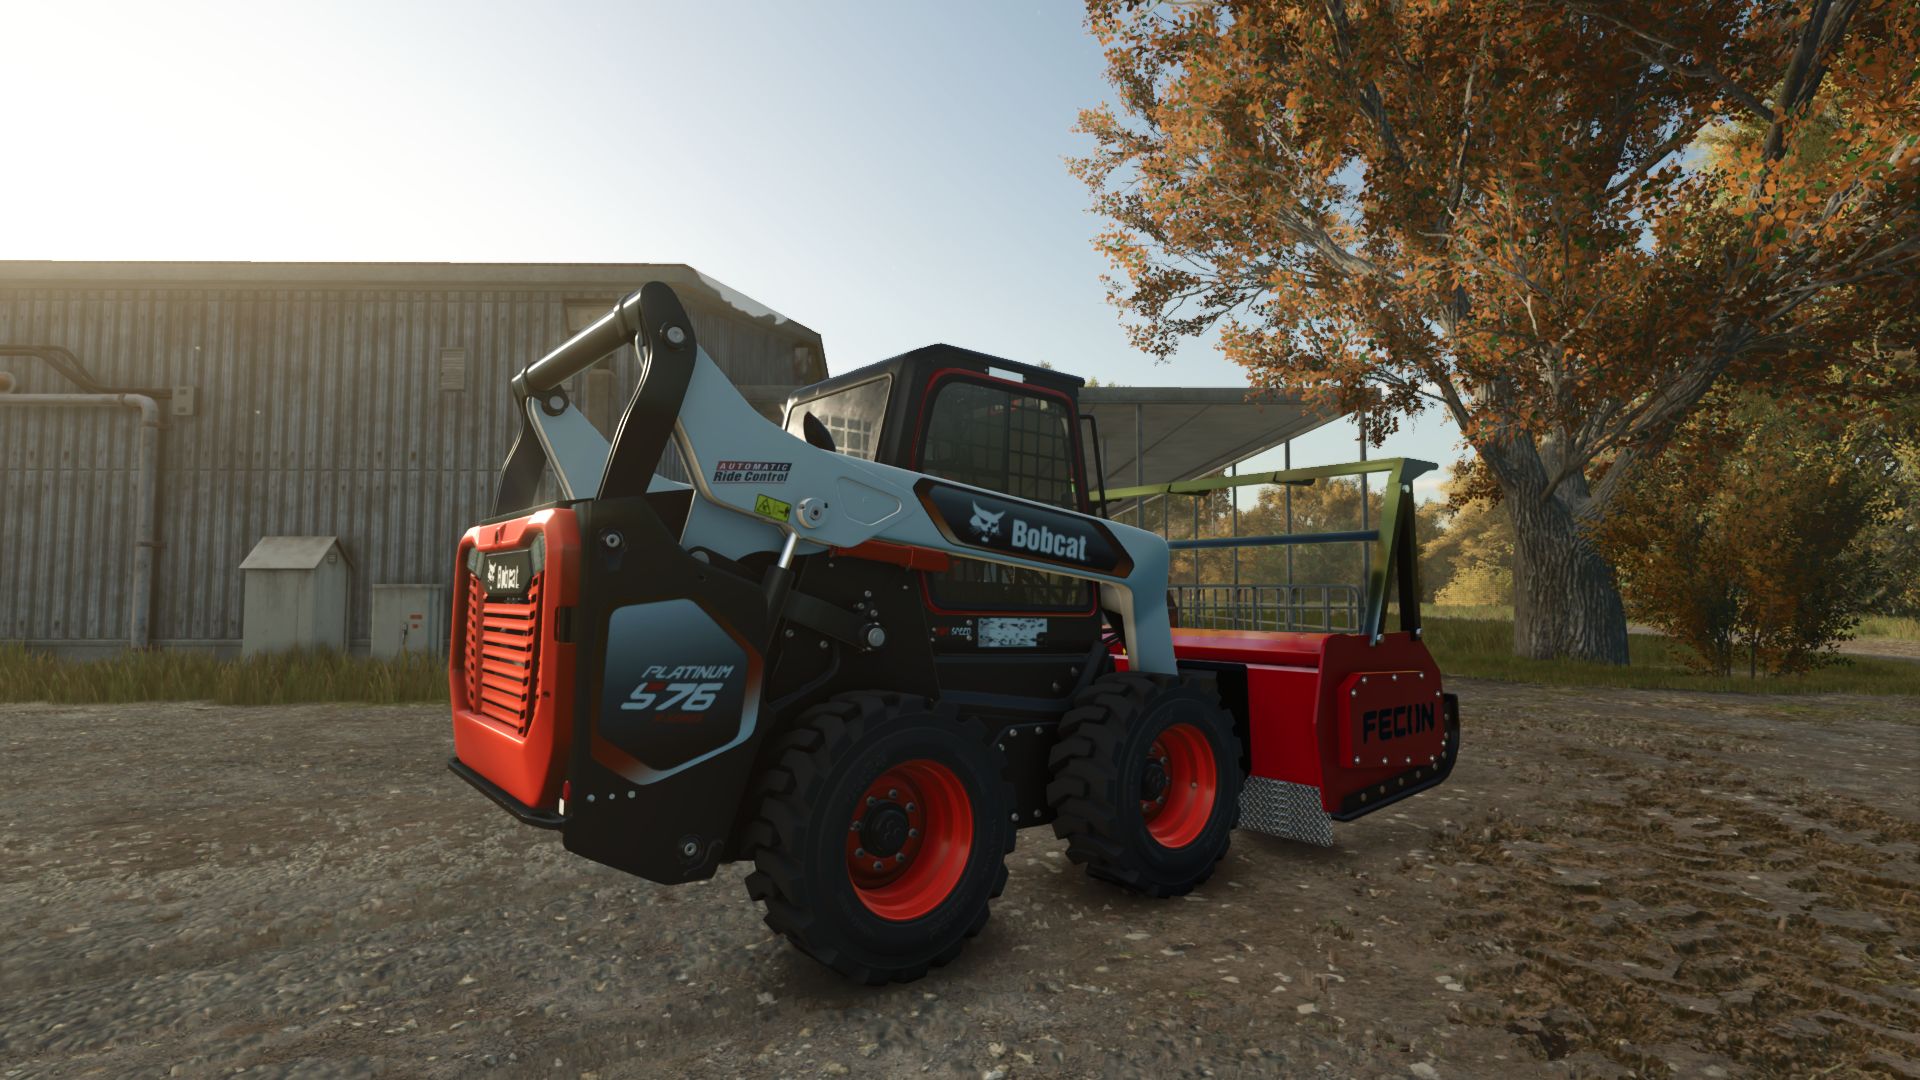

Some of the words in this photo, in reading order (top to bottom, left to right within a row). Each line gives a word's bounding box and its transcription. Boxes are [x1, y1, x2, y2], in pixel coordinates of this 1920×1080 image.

[719, 462, 789, 471] AUTOMATIC
[713, 471, 742, 482] Ride
[744, 471, 788, 482] Control
[1011, 519, 1087, 560] Bobcat
[641, 665, 734, 679] PLATINUM
[621, 682, 724, 711] S76
